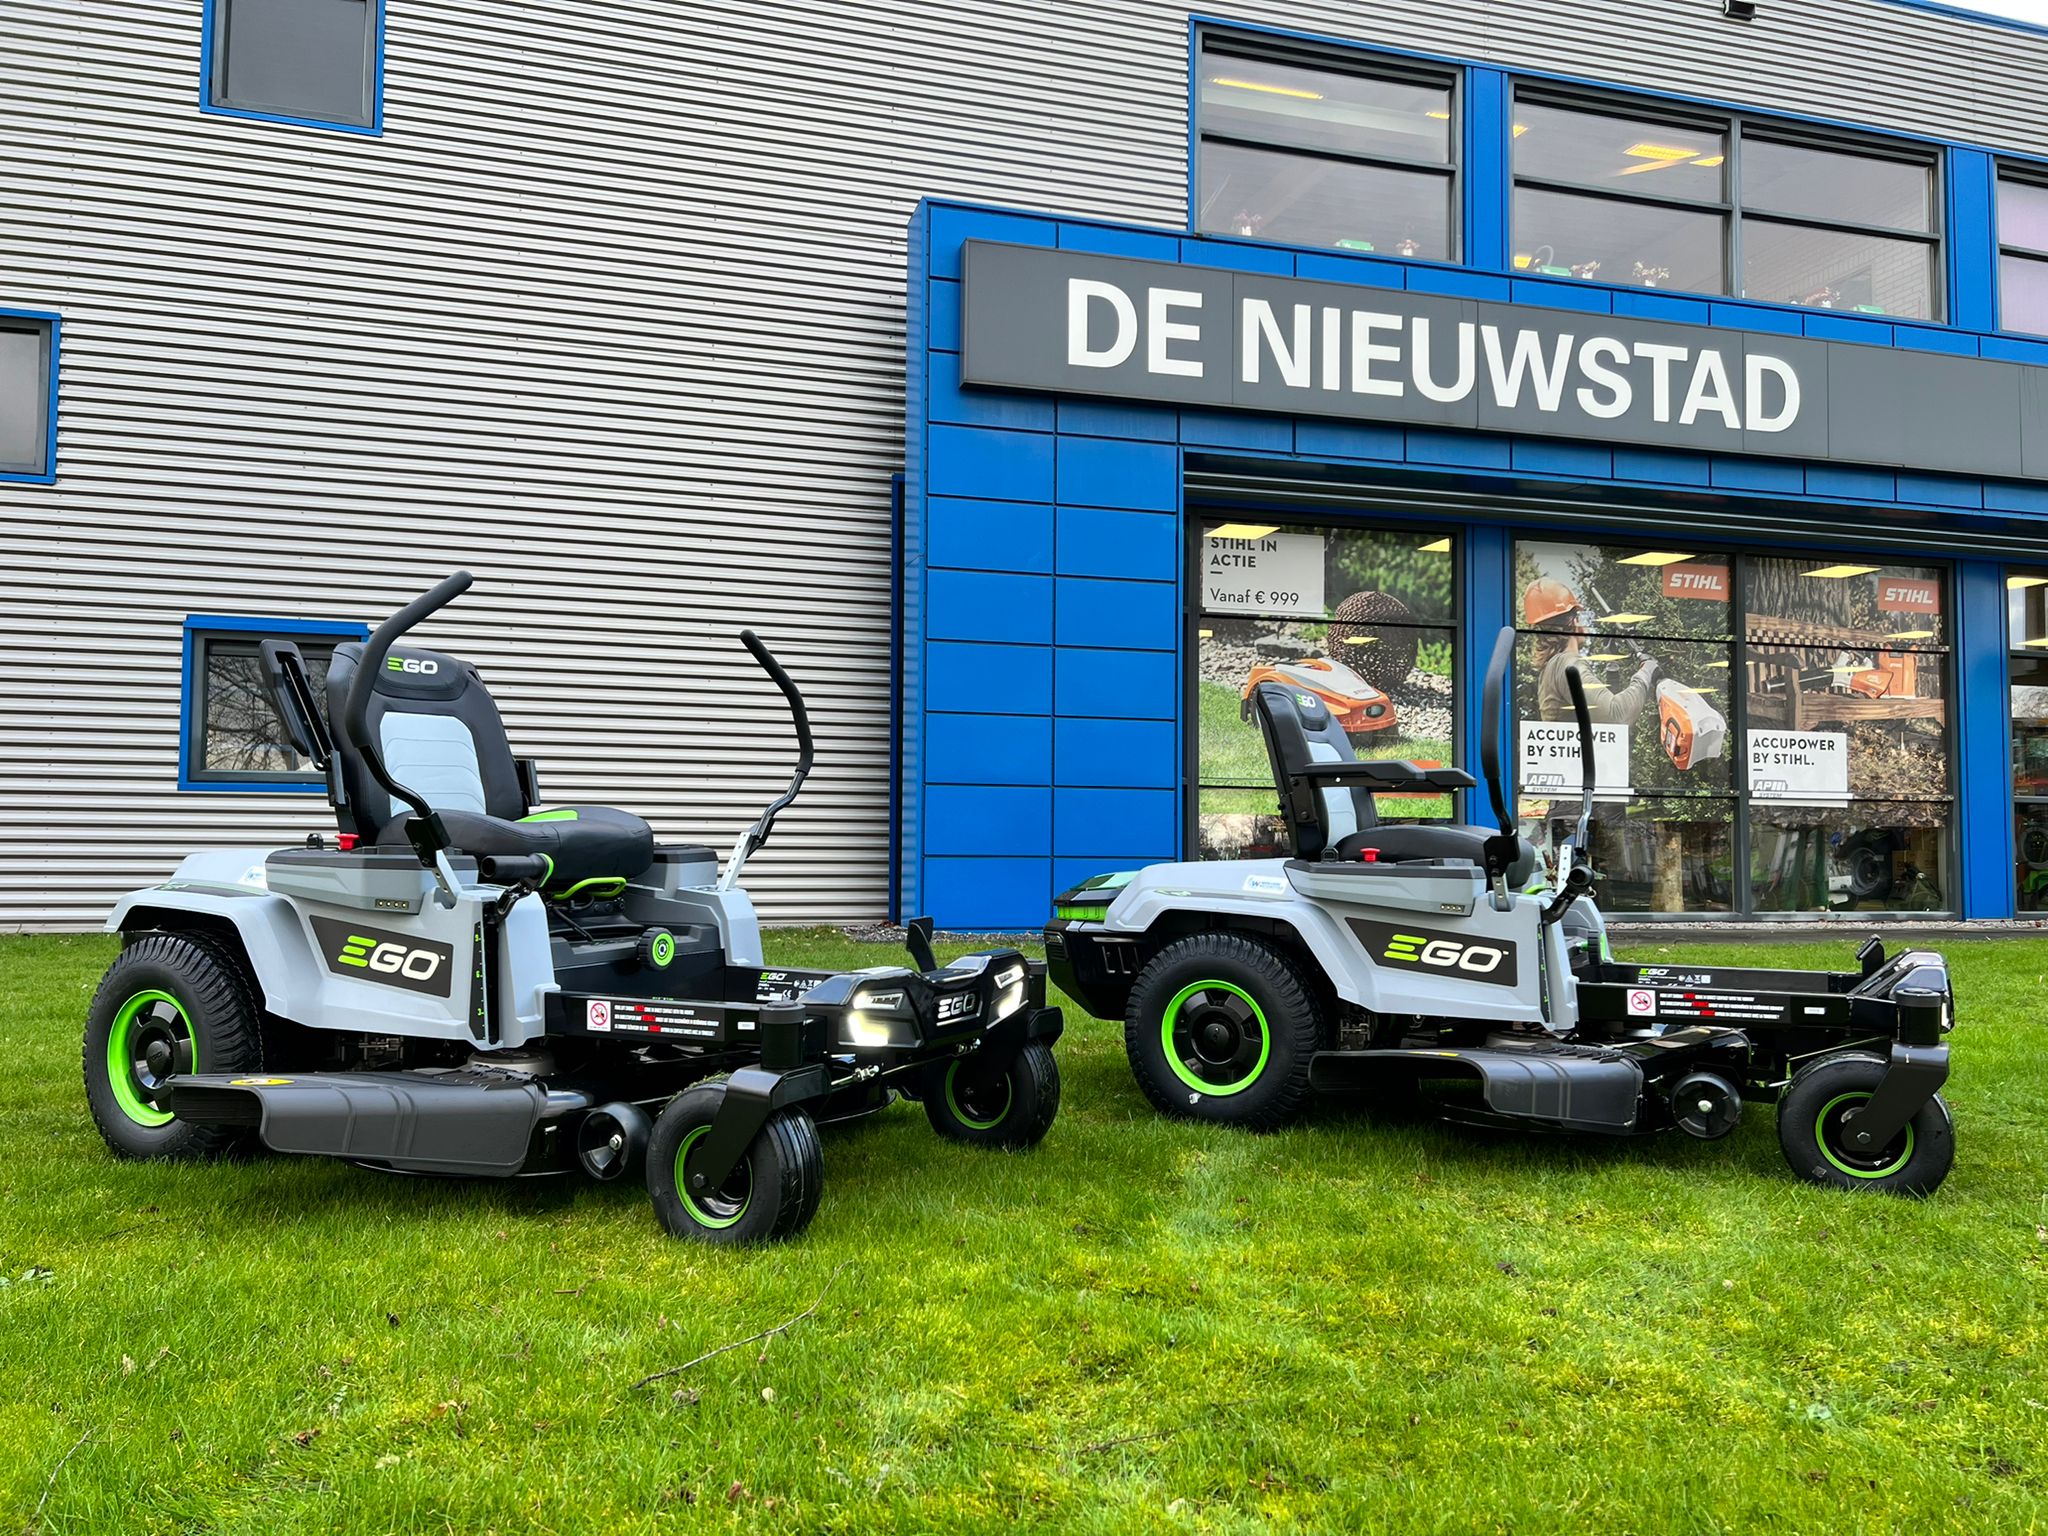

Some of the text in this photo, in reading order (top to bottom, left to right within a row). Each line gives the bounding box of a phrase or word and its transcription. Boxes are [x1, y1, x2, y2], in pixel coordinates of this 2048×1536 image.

[1068, 278, 1801, 433] DE NIEUWSTAD
[1211, 537, 1277, 552] STIHL IN
[1210, 554, 1256, 568] ACTIE
[1669, 573, 1722, 590] STIHL
[1210, 588, 1299, 606] Vanaf € 999
[1884, 587, 1933, 604] STIHL
[387, 656, 439, 675] EGO
[1527, 745, 1581, 758] BY STIH
[1753, 737, 1835, 751] ACCUPOWER
[1753, 753, 1815, 765] BY STIHL.
[338, 935, 440, 981] EGO
[1383, 934, 1503, 973] EGO
[938, 993, 975, 1019] EGO
